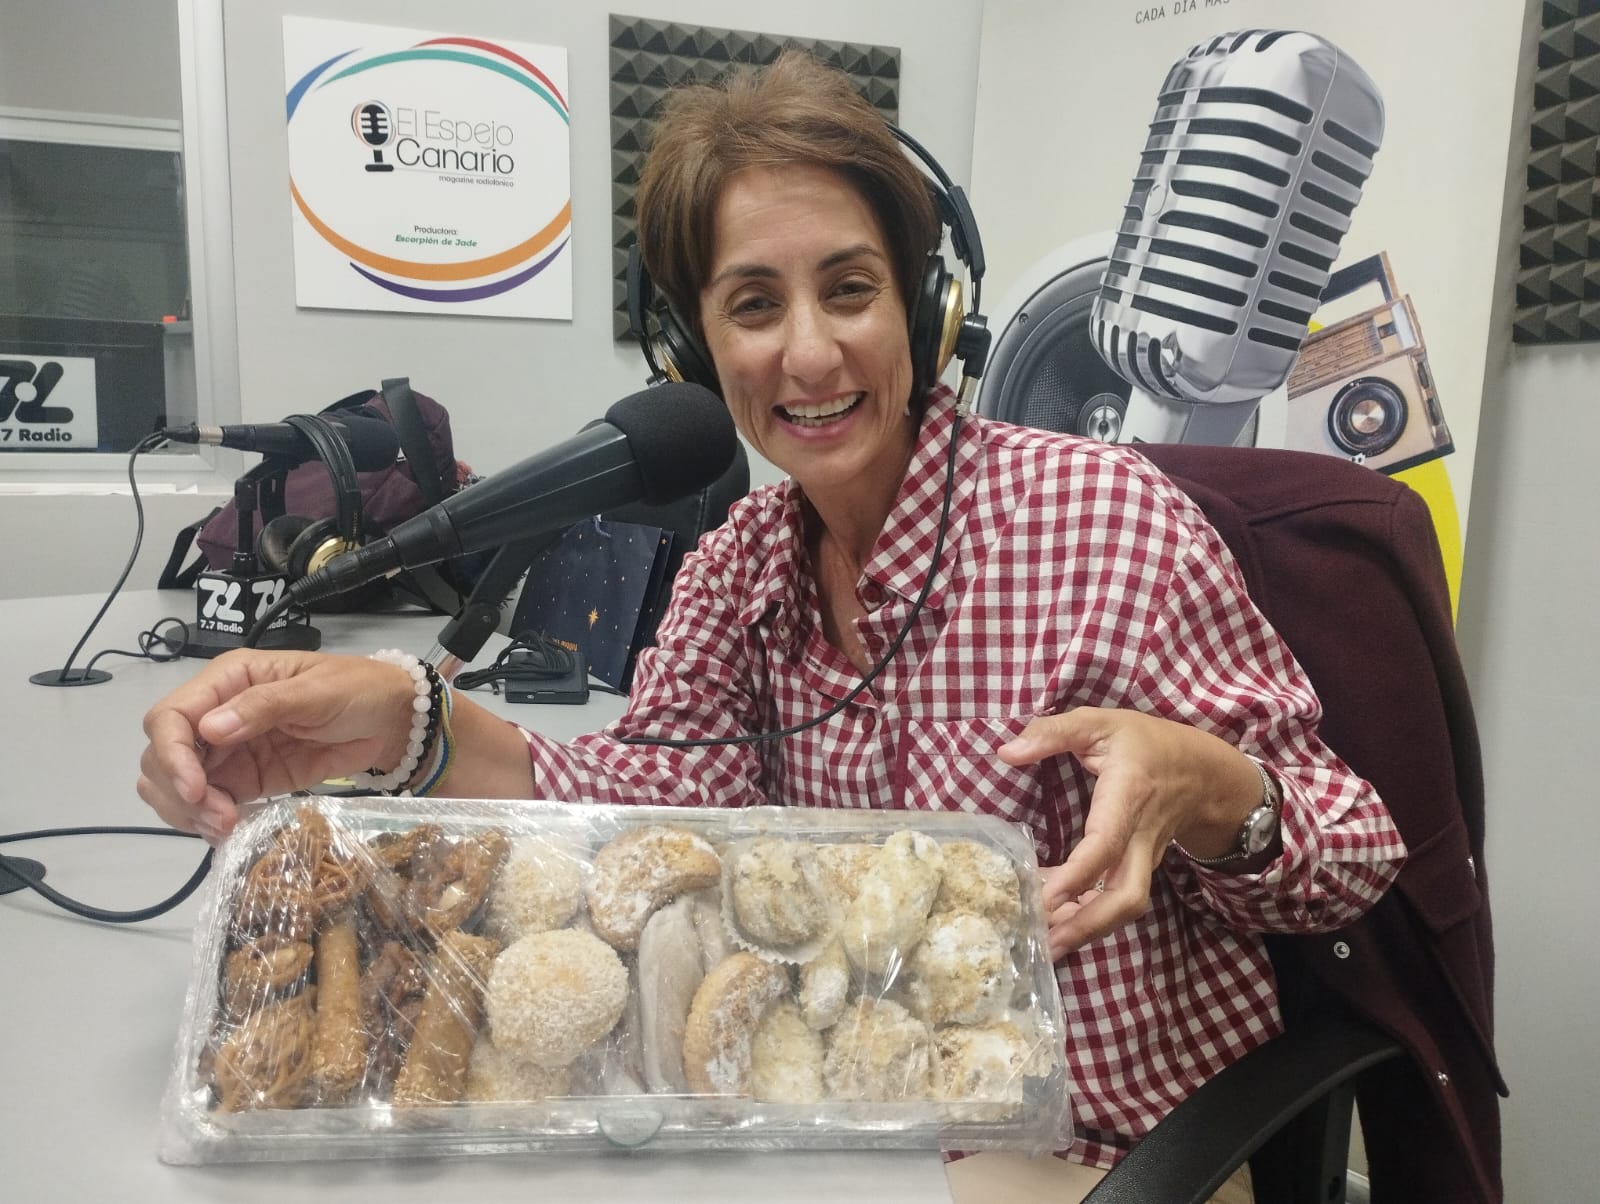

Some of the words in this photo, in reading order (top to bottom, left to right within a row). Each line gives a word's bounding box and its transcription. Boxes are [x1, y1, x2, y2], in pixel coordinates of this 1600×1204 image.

[1135, 6, 1165, 24] CADA
[1205, 0, 1230, 8] MA
[397, 107, 418, 138] El
[425, 110, 514, 150] Espejo
[396, 138, 515, 175] Canario
[439, 175, 474, 186] magazine
[441, 238, 453, 246] de
[455, 239, 478, 247] Jade
[19, 427, 73, 442] Radio
[200, 619, 216, 630] 7.7
[217, 622, 244, 634] Radio
[267, 618, 287, 630] adio
